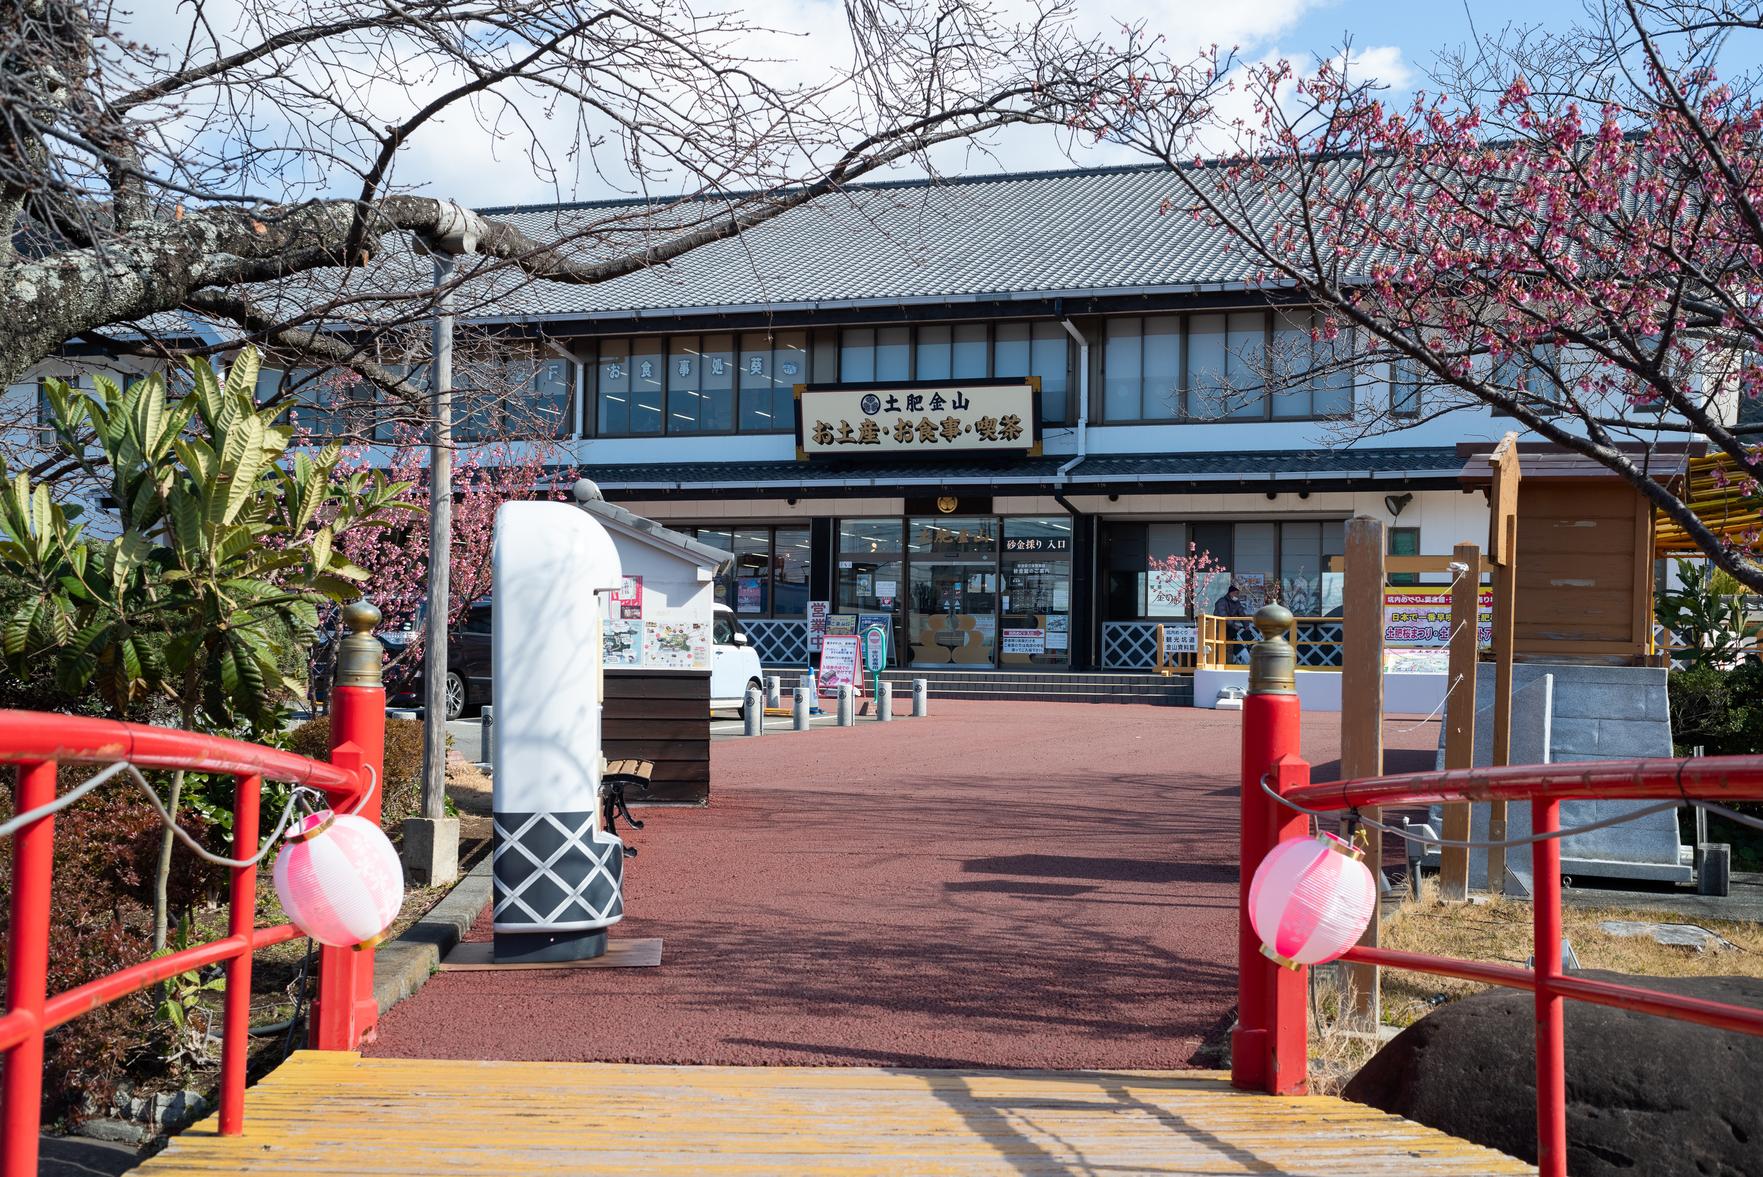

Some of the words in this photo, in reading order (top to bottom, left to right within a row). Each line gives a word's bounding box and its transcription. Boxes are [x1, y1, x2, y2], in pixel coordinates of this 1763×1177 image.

[884, 391, 970, 413] 土肥金山
[1006, 540, 1042, 550] 砂金採り
[1047, 540, 1066, 550] 入口
[811, 602, 827, 650] 営業中
